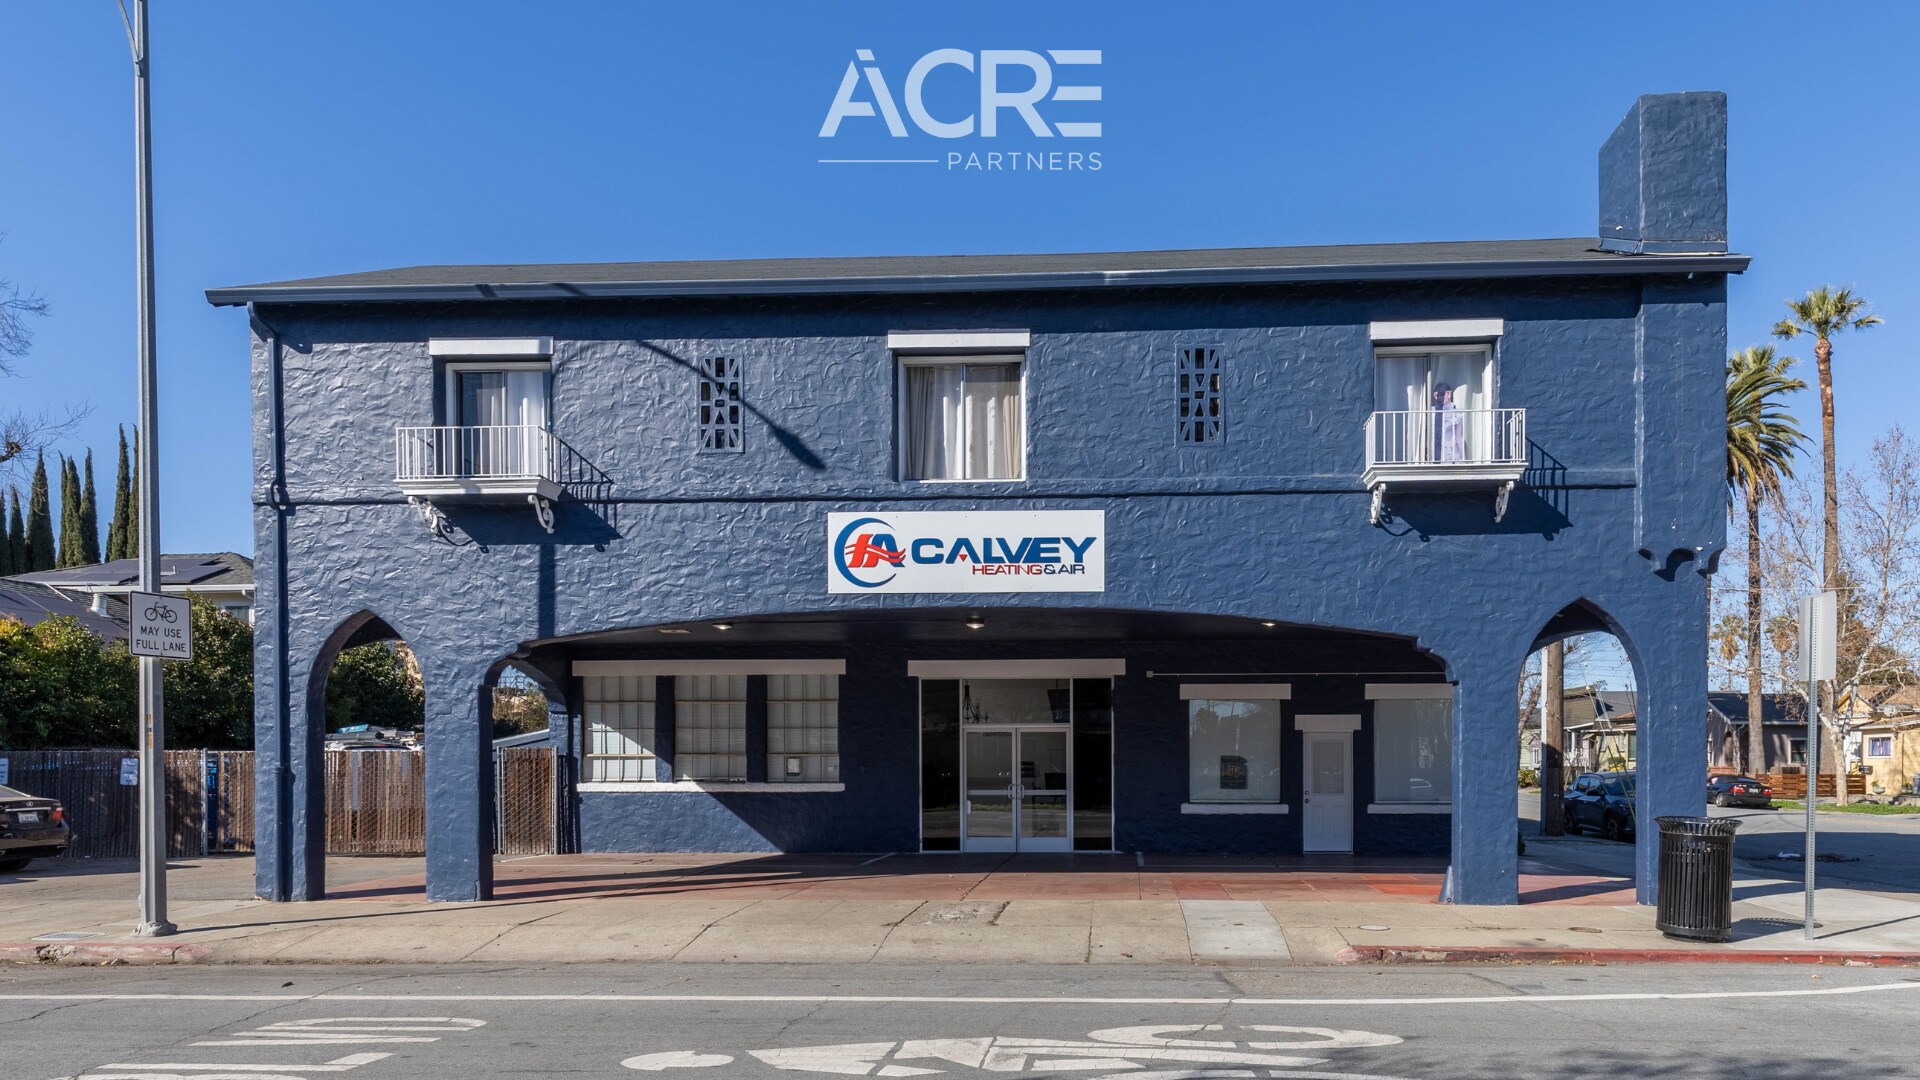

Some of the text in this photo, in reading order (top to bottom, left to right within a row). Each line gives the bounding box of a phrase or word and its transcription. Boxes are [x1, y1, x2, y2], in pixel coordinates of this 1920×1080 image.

[911, 536, 1097, 564] CALVEY
[140, 625, 182, 639] MAY USE
[136, 638, 187, 653] FULL LANE
